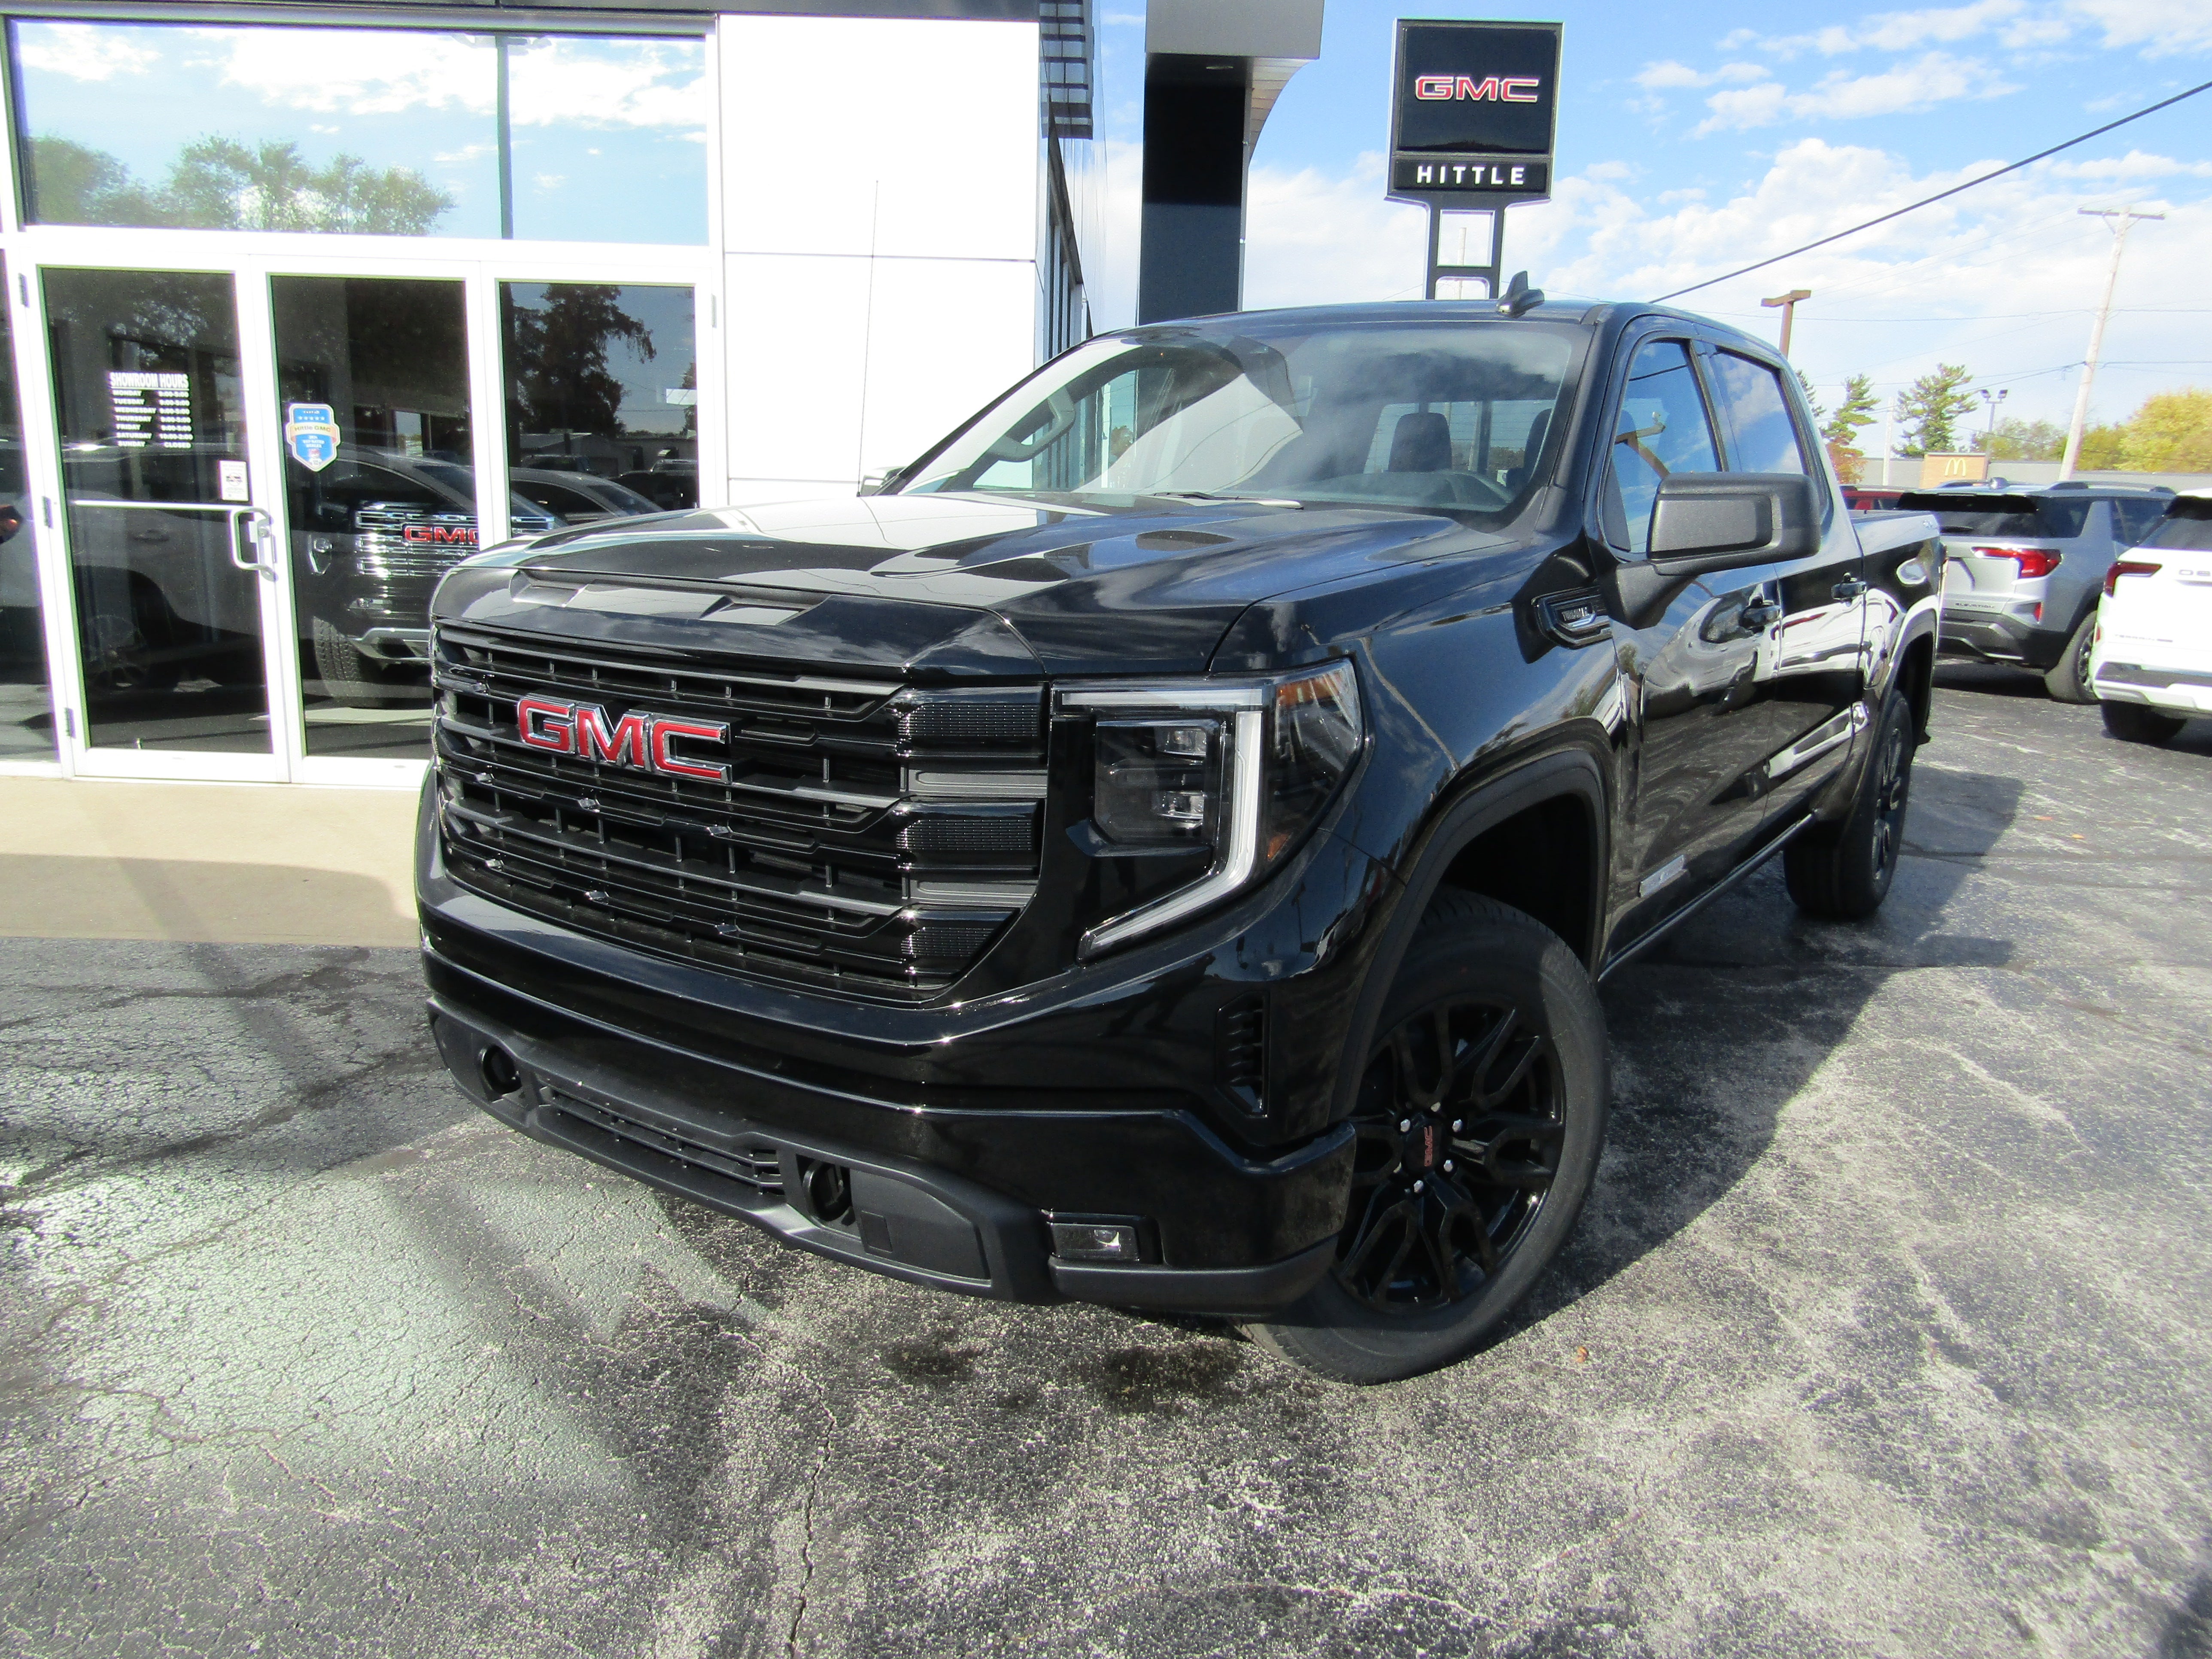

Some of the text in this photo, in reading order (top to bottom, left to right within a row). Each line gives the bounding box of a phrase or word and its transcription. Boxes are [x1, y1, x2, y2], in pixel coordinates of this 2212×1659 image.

[1415, 75, 1540, 103] GMC
[1416, 165, 1525, 185] HITTLE
[109, 372, 189, 388] SHOWROOM HOURS
[517, 693, 732, 785] GMC
[1424, 1125, 1433, 1167] GMC
